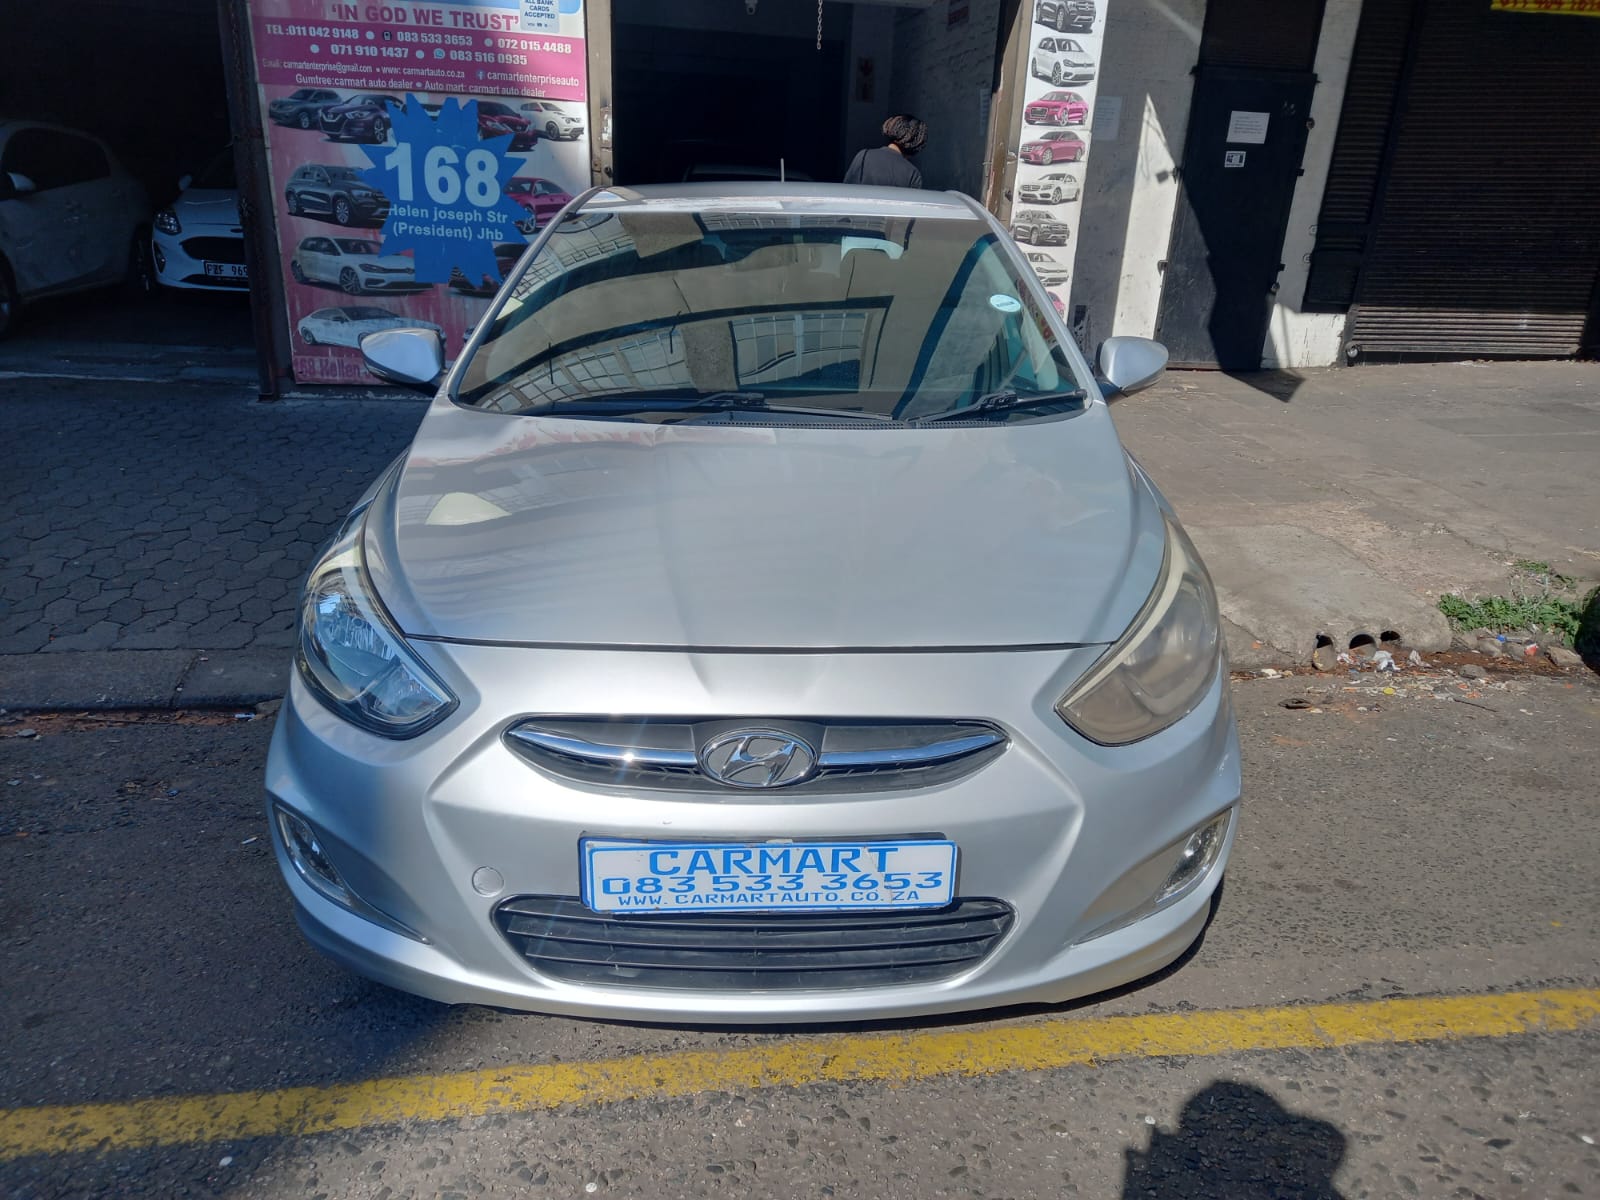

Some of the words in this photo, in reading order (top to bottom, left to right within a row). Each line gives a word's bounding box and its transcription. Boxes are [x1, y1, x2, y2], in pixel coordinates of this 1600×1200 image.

[365, 6, 407, 23] GOD
[413, 8, 443, 26] WE
[524, 11, 556, 19] ACCEPTED
[309, 26, 330, 38] 042
[332, 28, 359, 39] 9148
[397, 32, 419, 42] 083
[421, 34, 442, 43] 533
[444, 35, 473, 46] 3653
[497, 39, 518, 49] 072
[330, 44, 353, 55] 071
[355, 46, 378, 56] 910
[380, 47, 409, 58] 1437
[450, 50, 473, 61] 083
[475, 52, 495, 63] 516
[497, 53, 528, 65] 0935
[283, 61, 372, 73] carmartenterprise@gmail.com
[402, 67, 465, 78] carmartauto.co.za
[487, 72, 579, 87] carmartenterpriseauto
[368, 79, 387, 88] auto
[388, 81, 413, 90] dealer
[424, 80, 444, 91] Auto
[468, 84, 500, 95] carmart
[501, 87, 521, 96] auto
[521, 88, 546, 98] dealer
[385, 142, 501, 208] 168
[388, 204, 429, 219] Helen
[486, 211, 508, 224] Str
[392, 222, 473, 241] (President)
[477, 227, 504, 240] Jhb
[649, 847, 899, 876] CARMART
[602, 875, 696, 895] 083
[712, 873, 804, 892] 533
[821, 871, 943, 891] 3653
